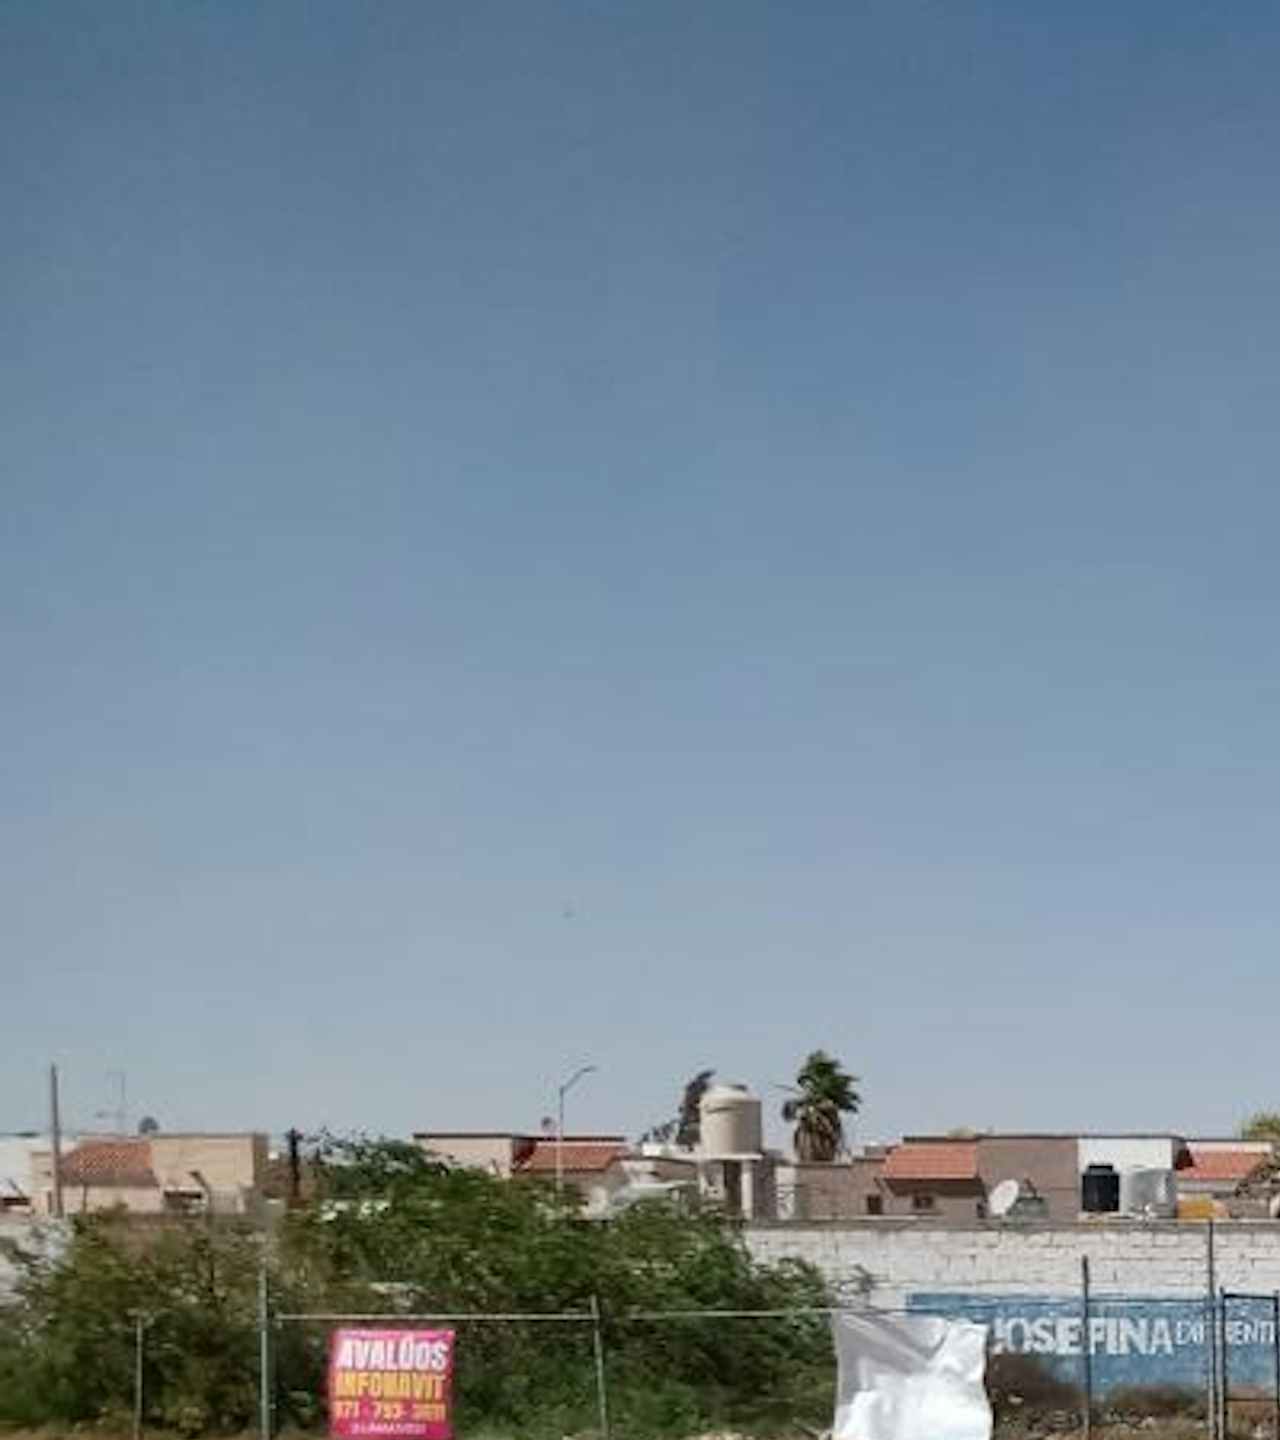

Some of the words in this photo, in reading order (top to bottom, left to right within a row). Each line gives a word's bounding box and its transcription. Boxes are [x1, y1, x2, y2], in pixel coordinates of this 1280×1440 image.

[336, 1334, 449, 1371] AVALÚOS
[992, 1317, 1174, 1355] JOSEFINA
[335, 1371, 446, 1400] INFONAVIT
